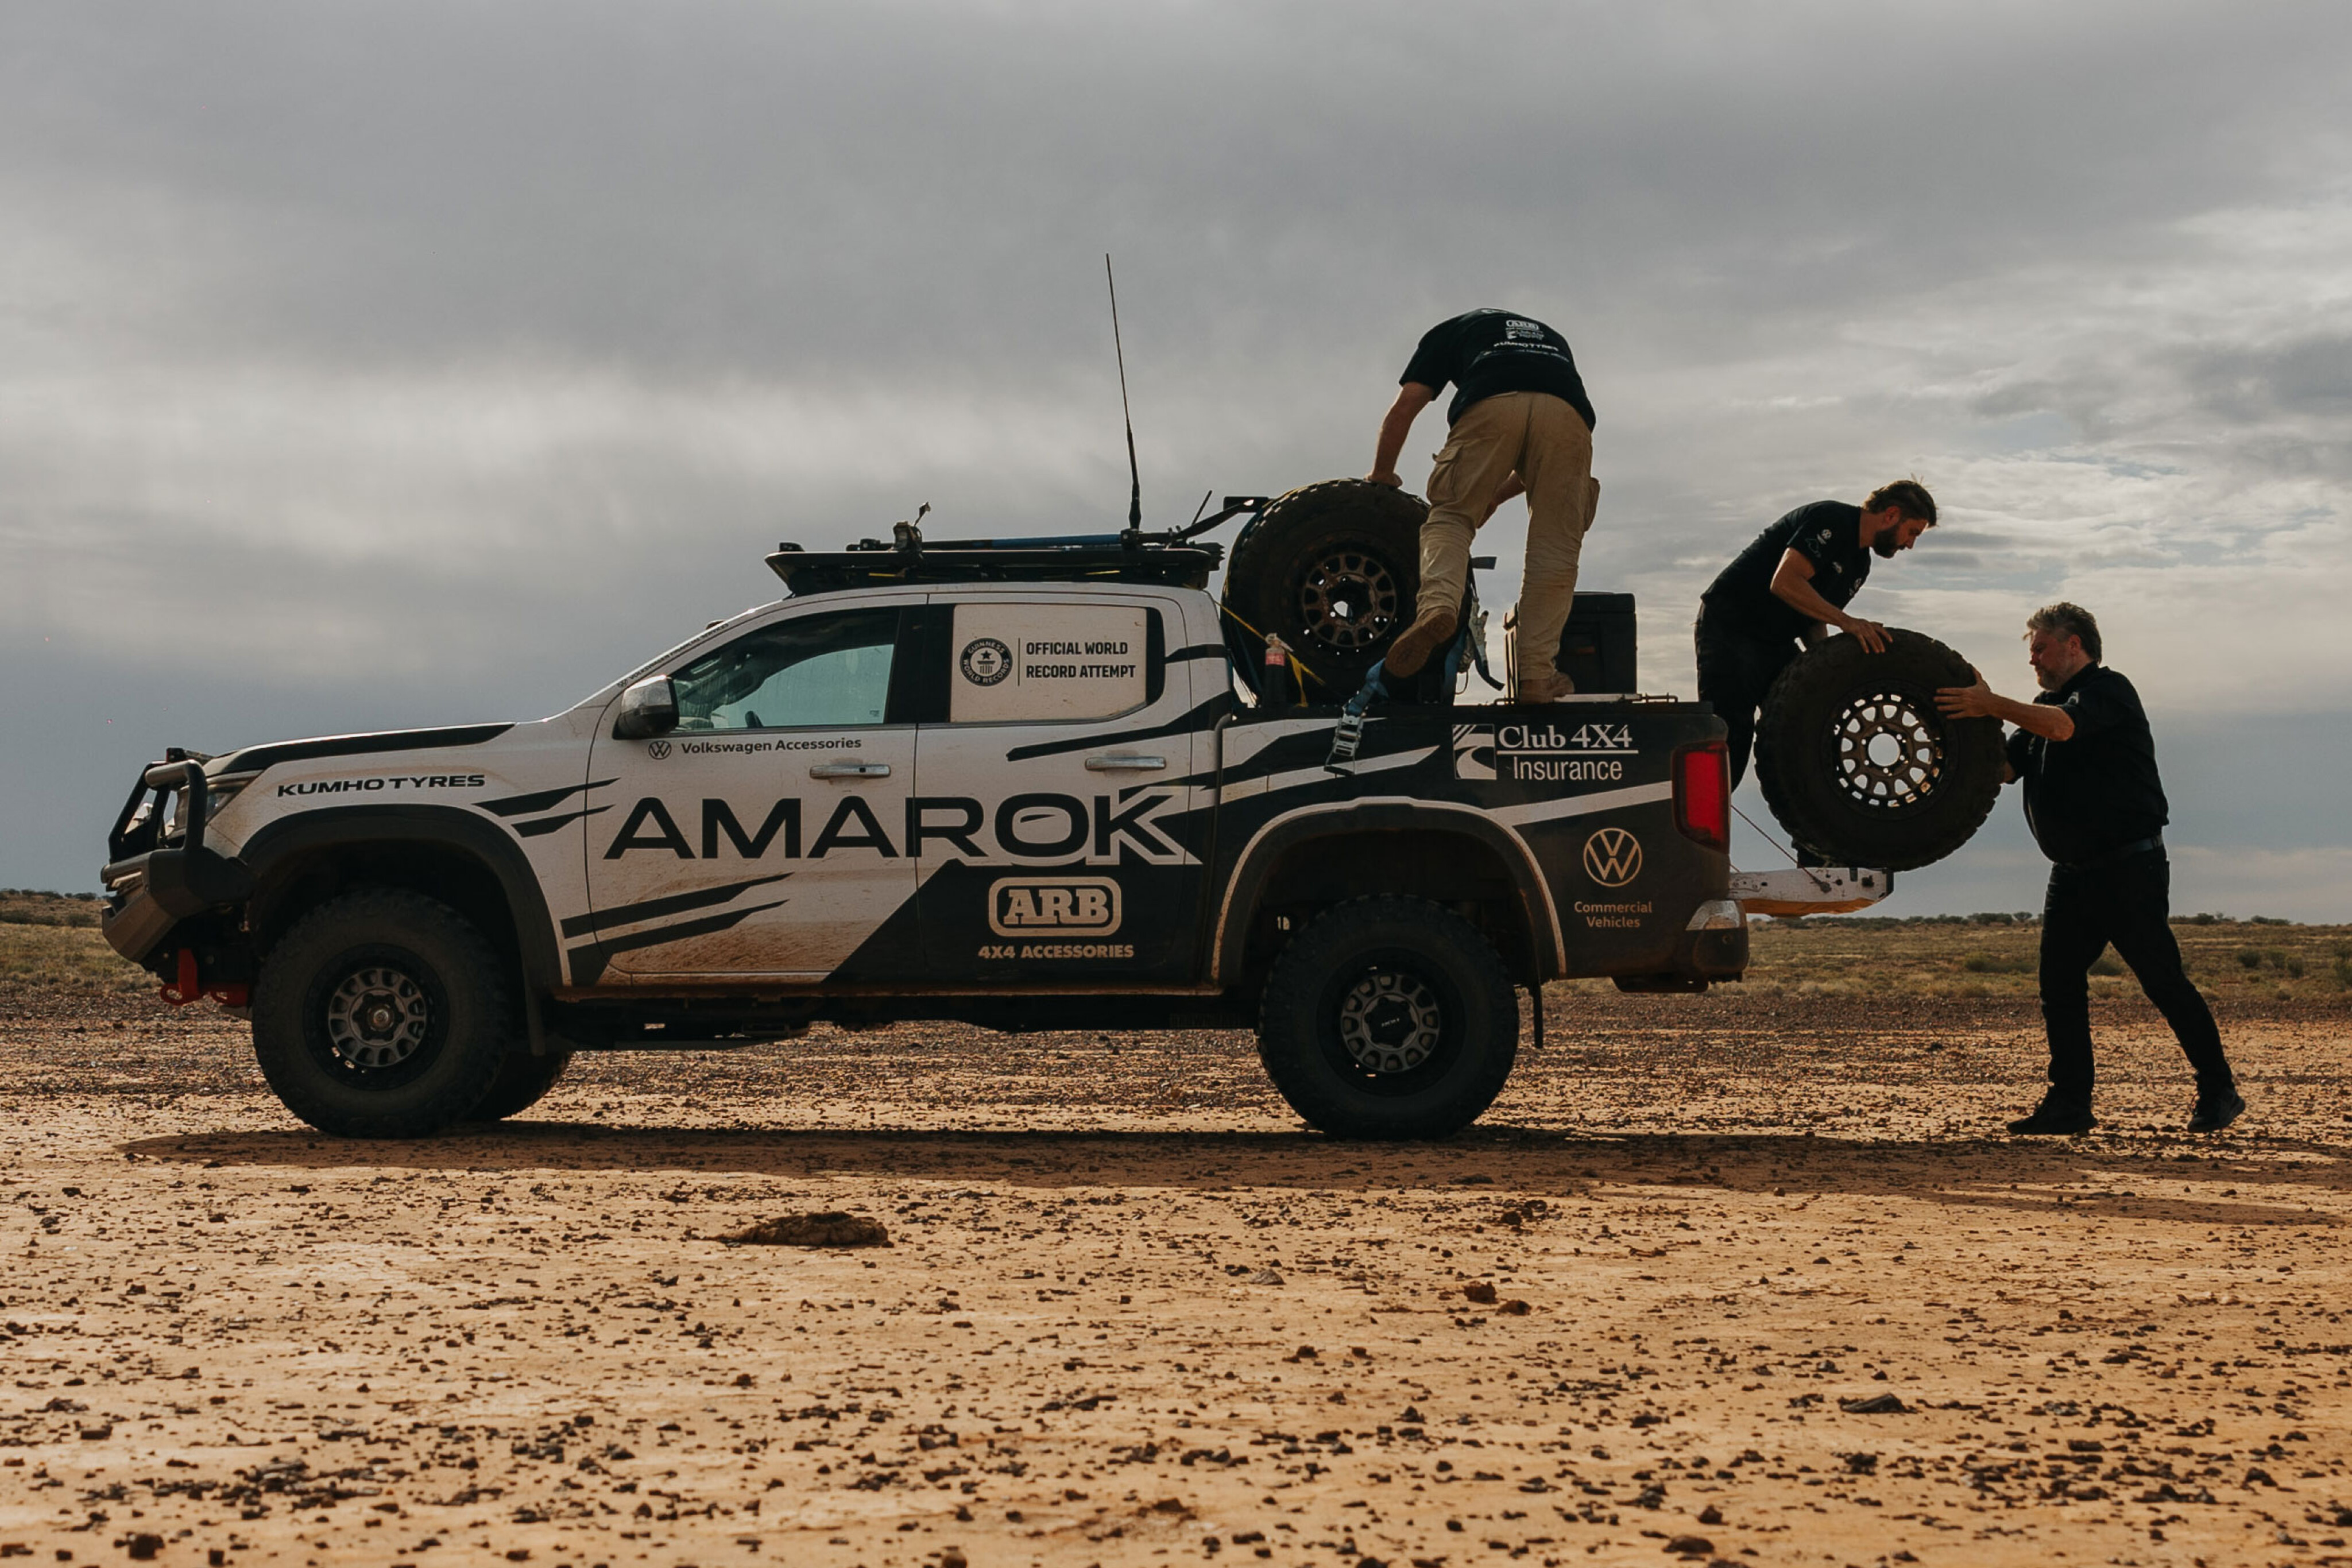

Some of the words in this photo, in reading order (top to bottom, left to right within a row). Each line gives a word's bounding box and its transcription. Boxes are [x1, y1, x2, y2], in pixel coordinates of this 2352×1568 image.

[968, 641, 1005, 653] GUINNESS
[1026, 642, 1081, 655] OFFICIAL
[1084, 642, 1128, 655] WORLD
[963, 659, 980, 682] WORLD
[982, 659, 1009, 683] RECORDS
[1026, 665, 1077, 678] RECORD
[1079, 665, 1136, 678] ATTEMPT
[1498, 724, 1566, 748] Club
[1570, 724, 1633, 748] 4X4
[682, 741, 772, 754] Volkswagen
[775, 737, 862, 751] Accessories
[1513, 756, 1623, 781] Insurance
[278, 779, 384, 797] KUMHO
[389, 775, 485, 788] TYRES
[603, 792, 1178, 860] AMAROK
[1003, 889, 1109, 924] ARB
[1574, 900, 1653, 913] Commercial
[1586, 916, 1641, 928] Vehicles
[978, 946, 1015, 958] 4X4
[1021, 945, 1134, 958] ACCESSORIES
